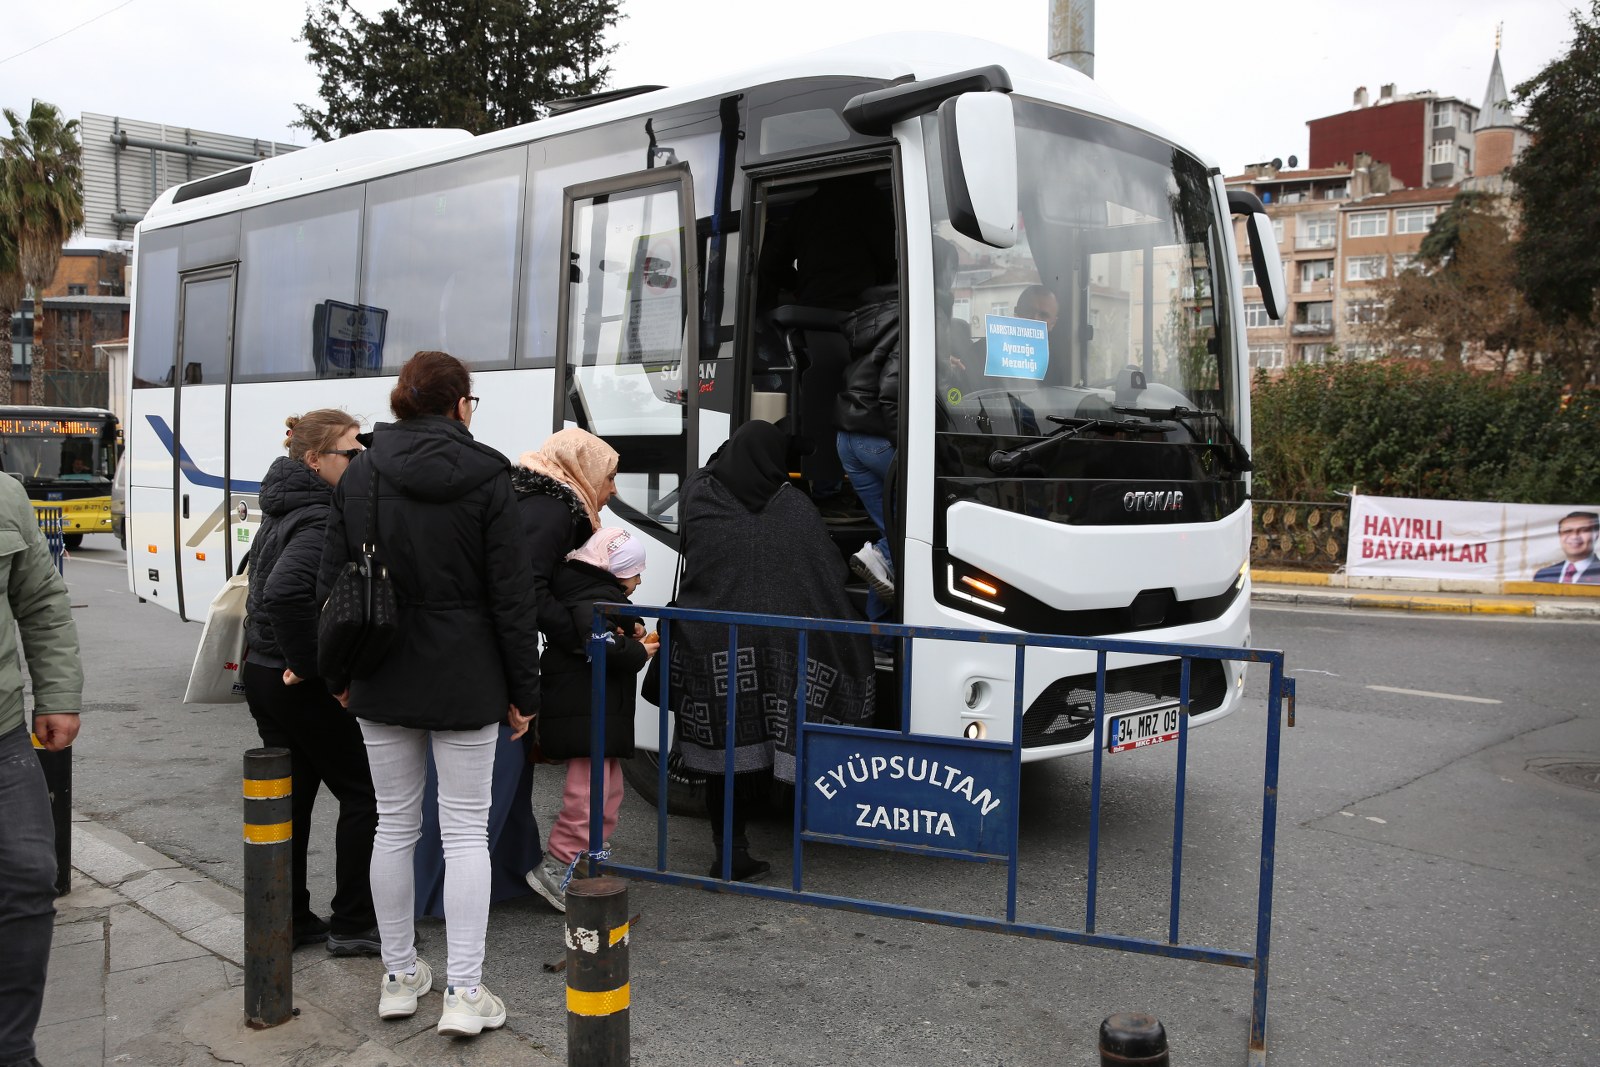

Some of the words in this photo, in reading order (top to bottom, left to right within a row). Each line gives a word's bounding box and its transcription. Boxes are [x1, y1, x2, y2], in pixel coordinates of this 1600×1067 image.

[1003, 342, 1035, 357] Ayazağa
[661, 363, 717, 380] SUAN
[1002, 357, 1037, 372] Mezarlığı
[1123, 491, 1184, 512] OTOKAR
[1363, 515, 1442, 540] HAYIRLI
[1361, 541, 1487, 563] BAYRAMLAR
[224, 662, 239, 671] 3M
[1119, 718, 1132, 742] 34
[1138, 713, 1159, 738] MRZ
[1163, 709, 1177, 732] 09
[814, 753, 1000, 816] EYÜPSULTAN
[856, 803, 956, 837] ZABITA
